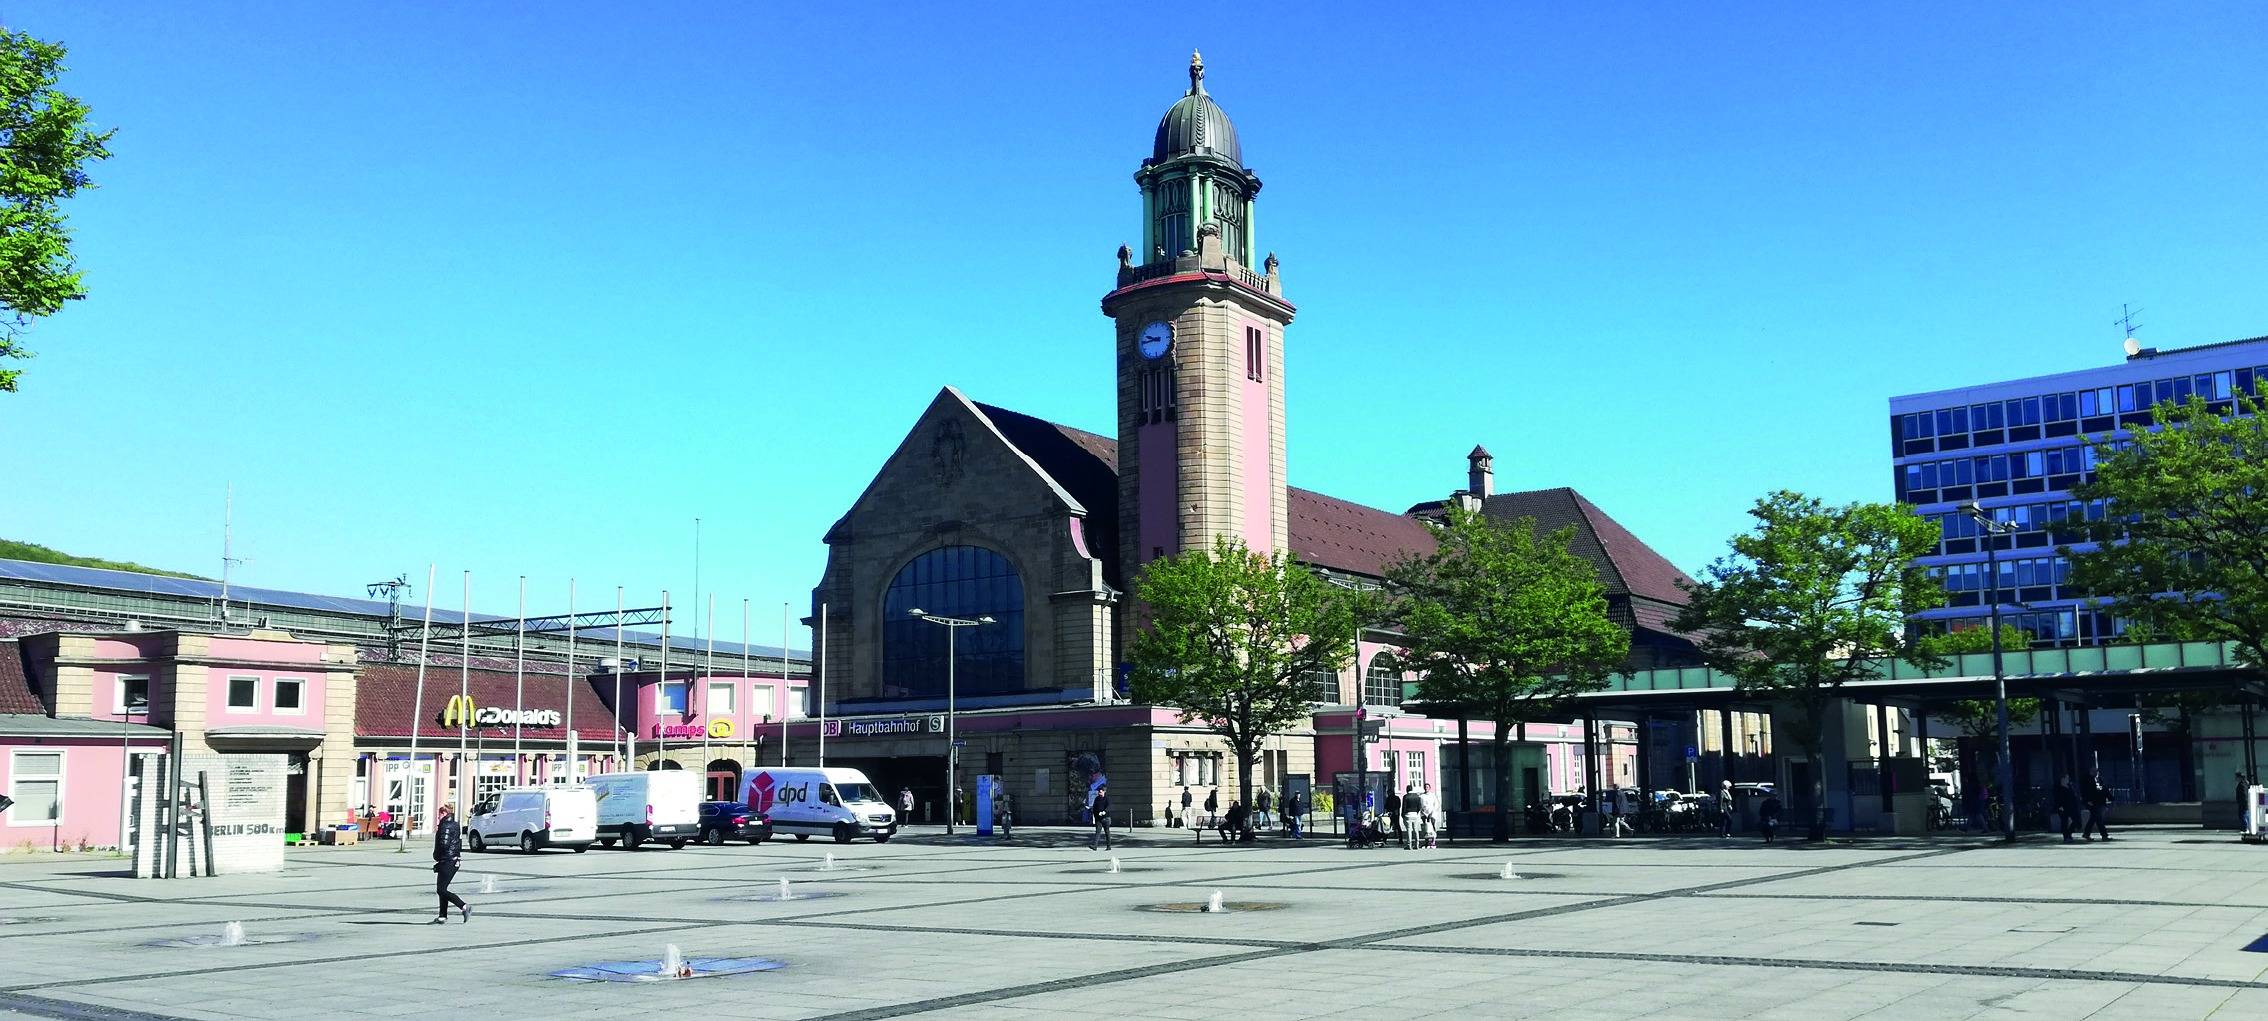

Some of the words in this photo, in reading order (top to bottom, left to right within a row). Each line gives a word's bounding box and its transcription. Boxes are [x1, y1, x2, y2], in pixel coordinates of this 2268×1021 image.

[444, 694, 561, 727] McDonald's
[655, 723, 705, 737] kamps
[848, 719, 921, 737] Hauptbahnhof
[778, 781, 808, 807] dpd
